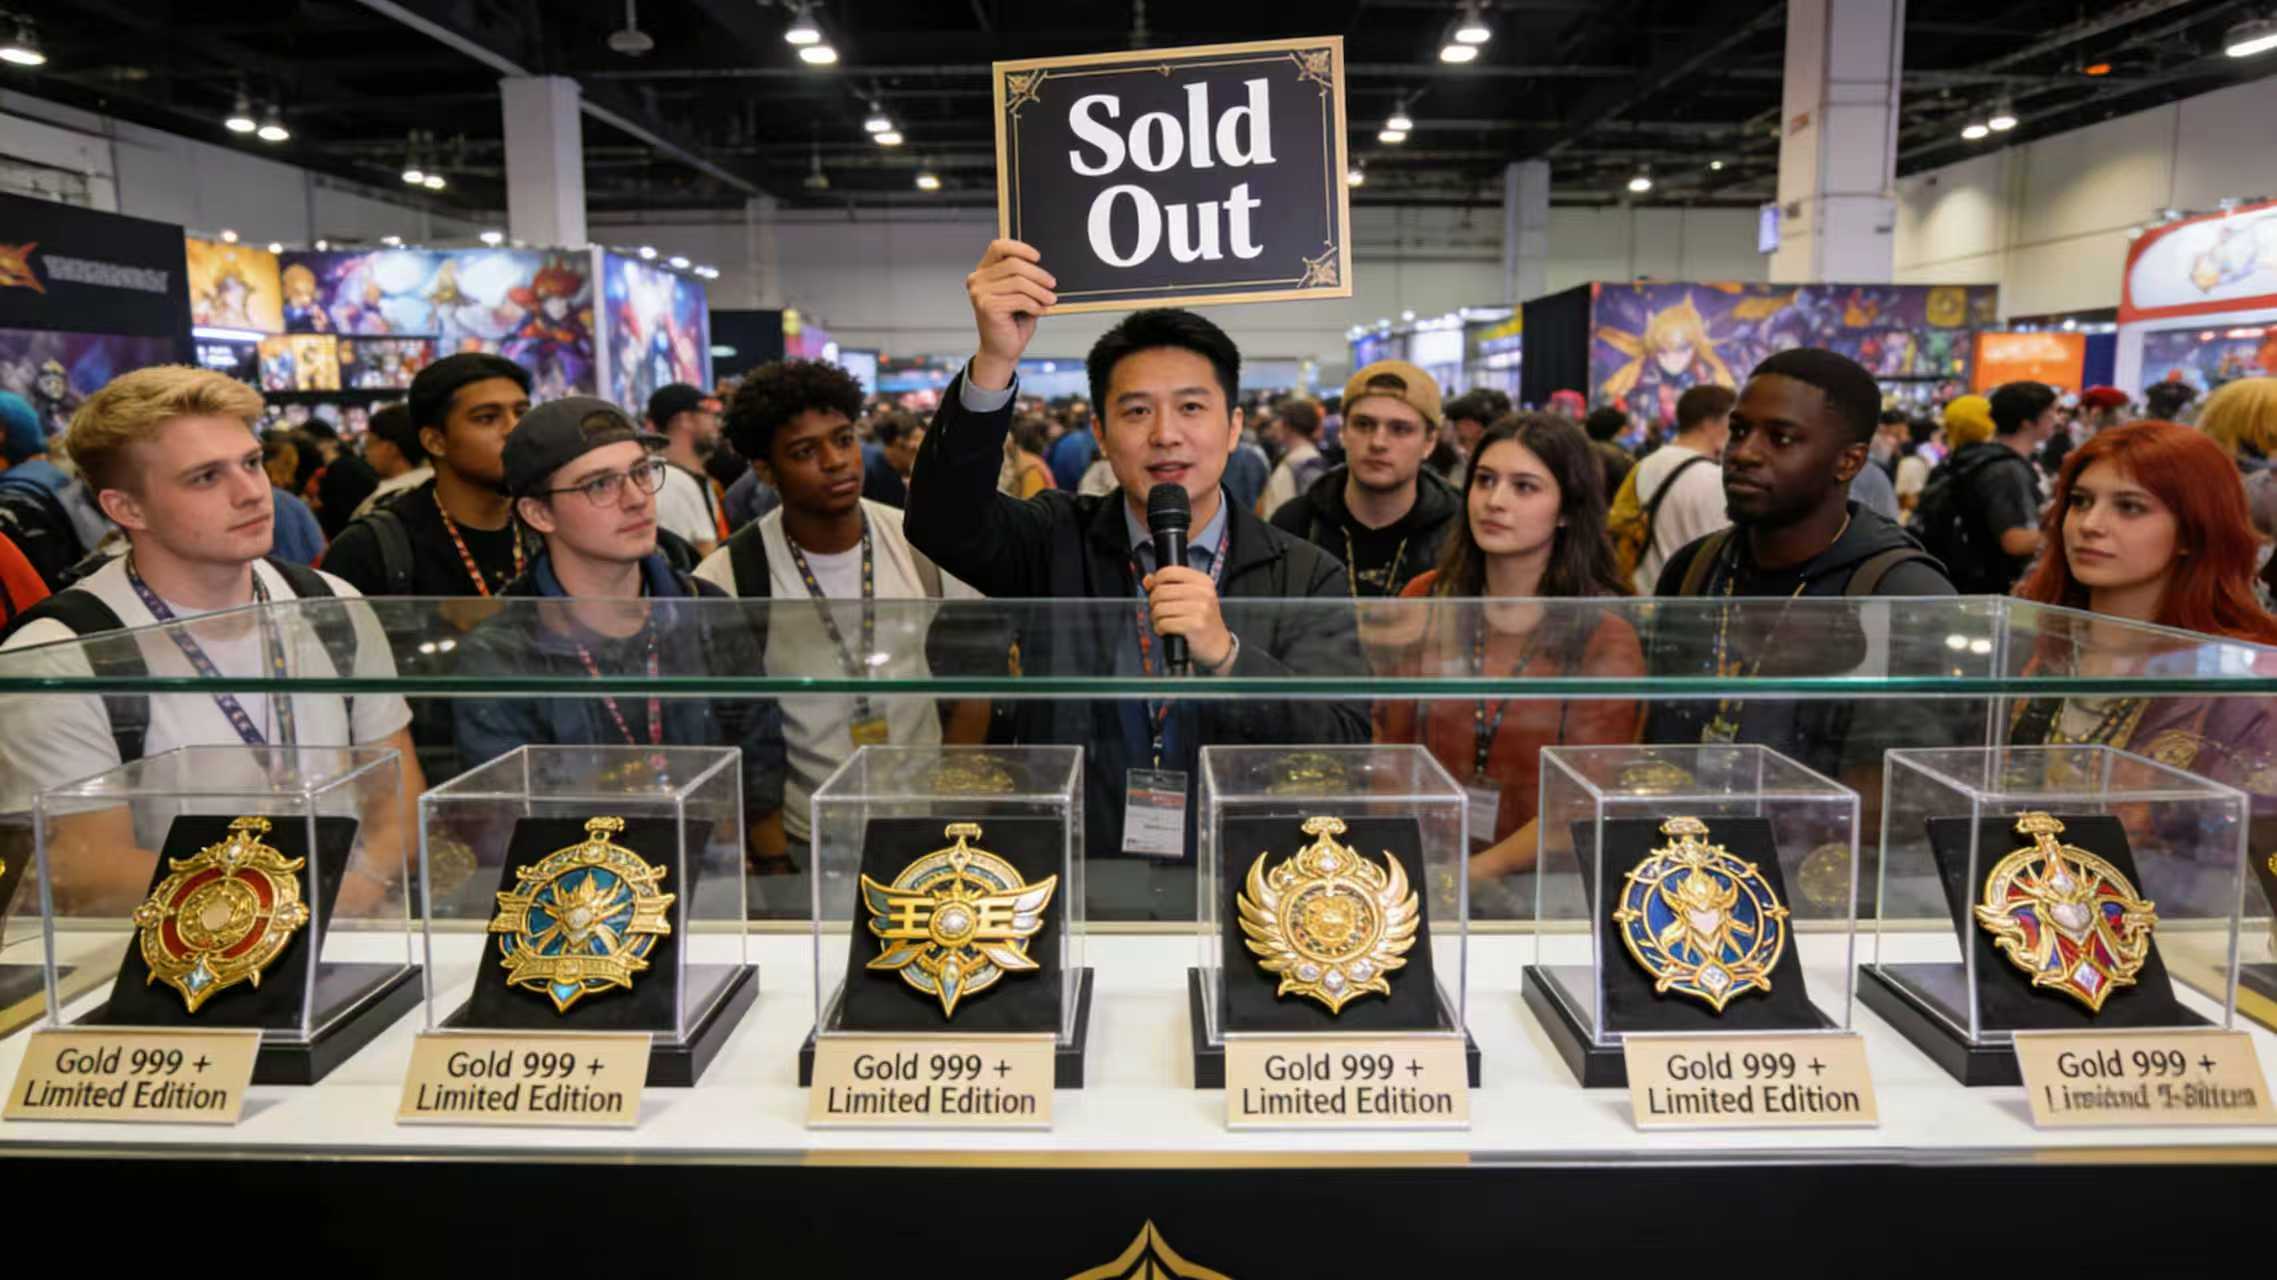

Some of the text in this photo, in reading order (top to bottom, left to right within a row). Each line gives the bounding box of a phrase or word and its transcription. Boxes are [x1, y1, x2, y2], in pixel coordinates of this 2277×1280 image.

[1068, 77, 1277, 177] Sold
[1087, 182, 1264, 268] Out
[56, 1047, 211, 1076] Gold 999 +
[447, 1050, 604, 1078] Gold 999 +
[853, 1052, 1012, 1080] Gold 999 +
[1264, 1052, 1424, 1080] Gold 999 +
[1667, 1051, 1827, 1080] Gold 999 +
[2057, 1049, 2217, 1078] Gold 999 +
[23, 1080, 227, 1110] Limited Edition
[415, 1083, 623, 1113] Limited Edition
[827, 1085, 1036, 1114] Limited Edition
[1243, 1085, 1452, 1115] Limited Edition
[1648, 1083, 1860, 1114] Limited Edition
